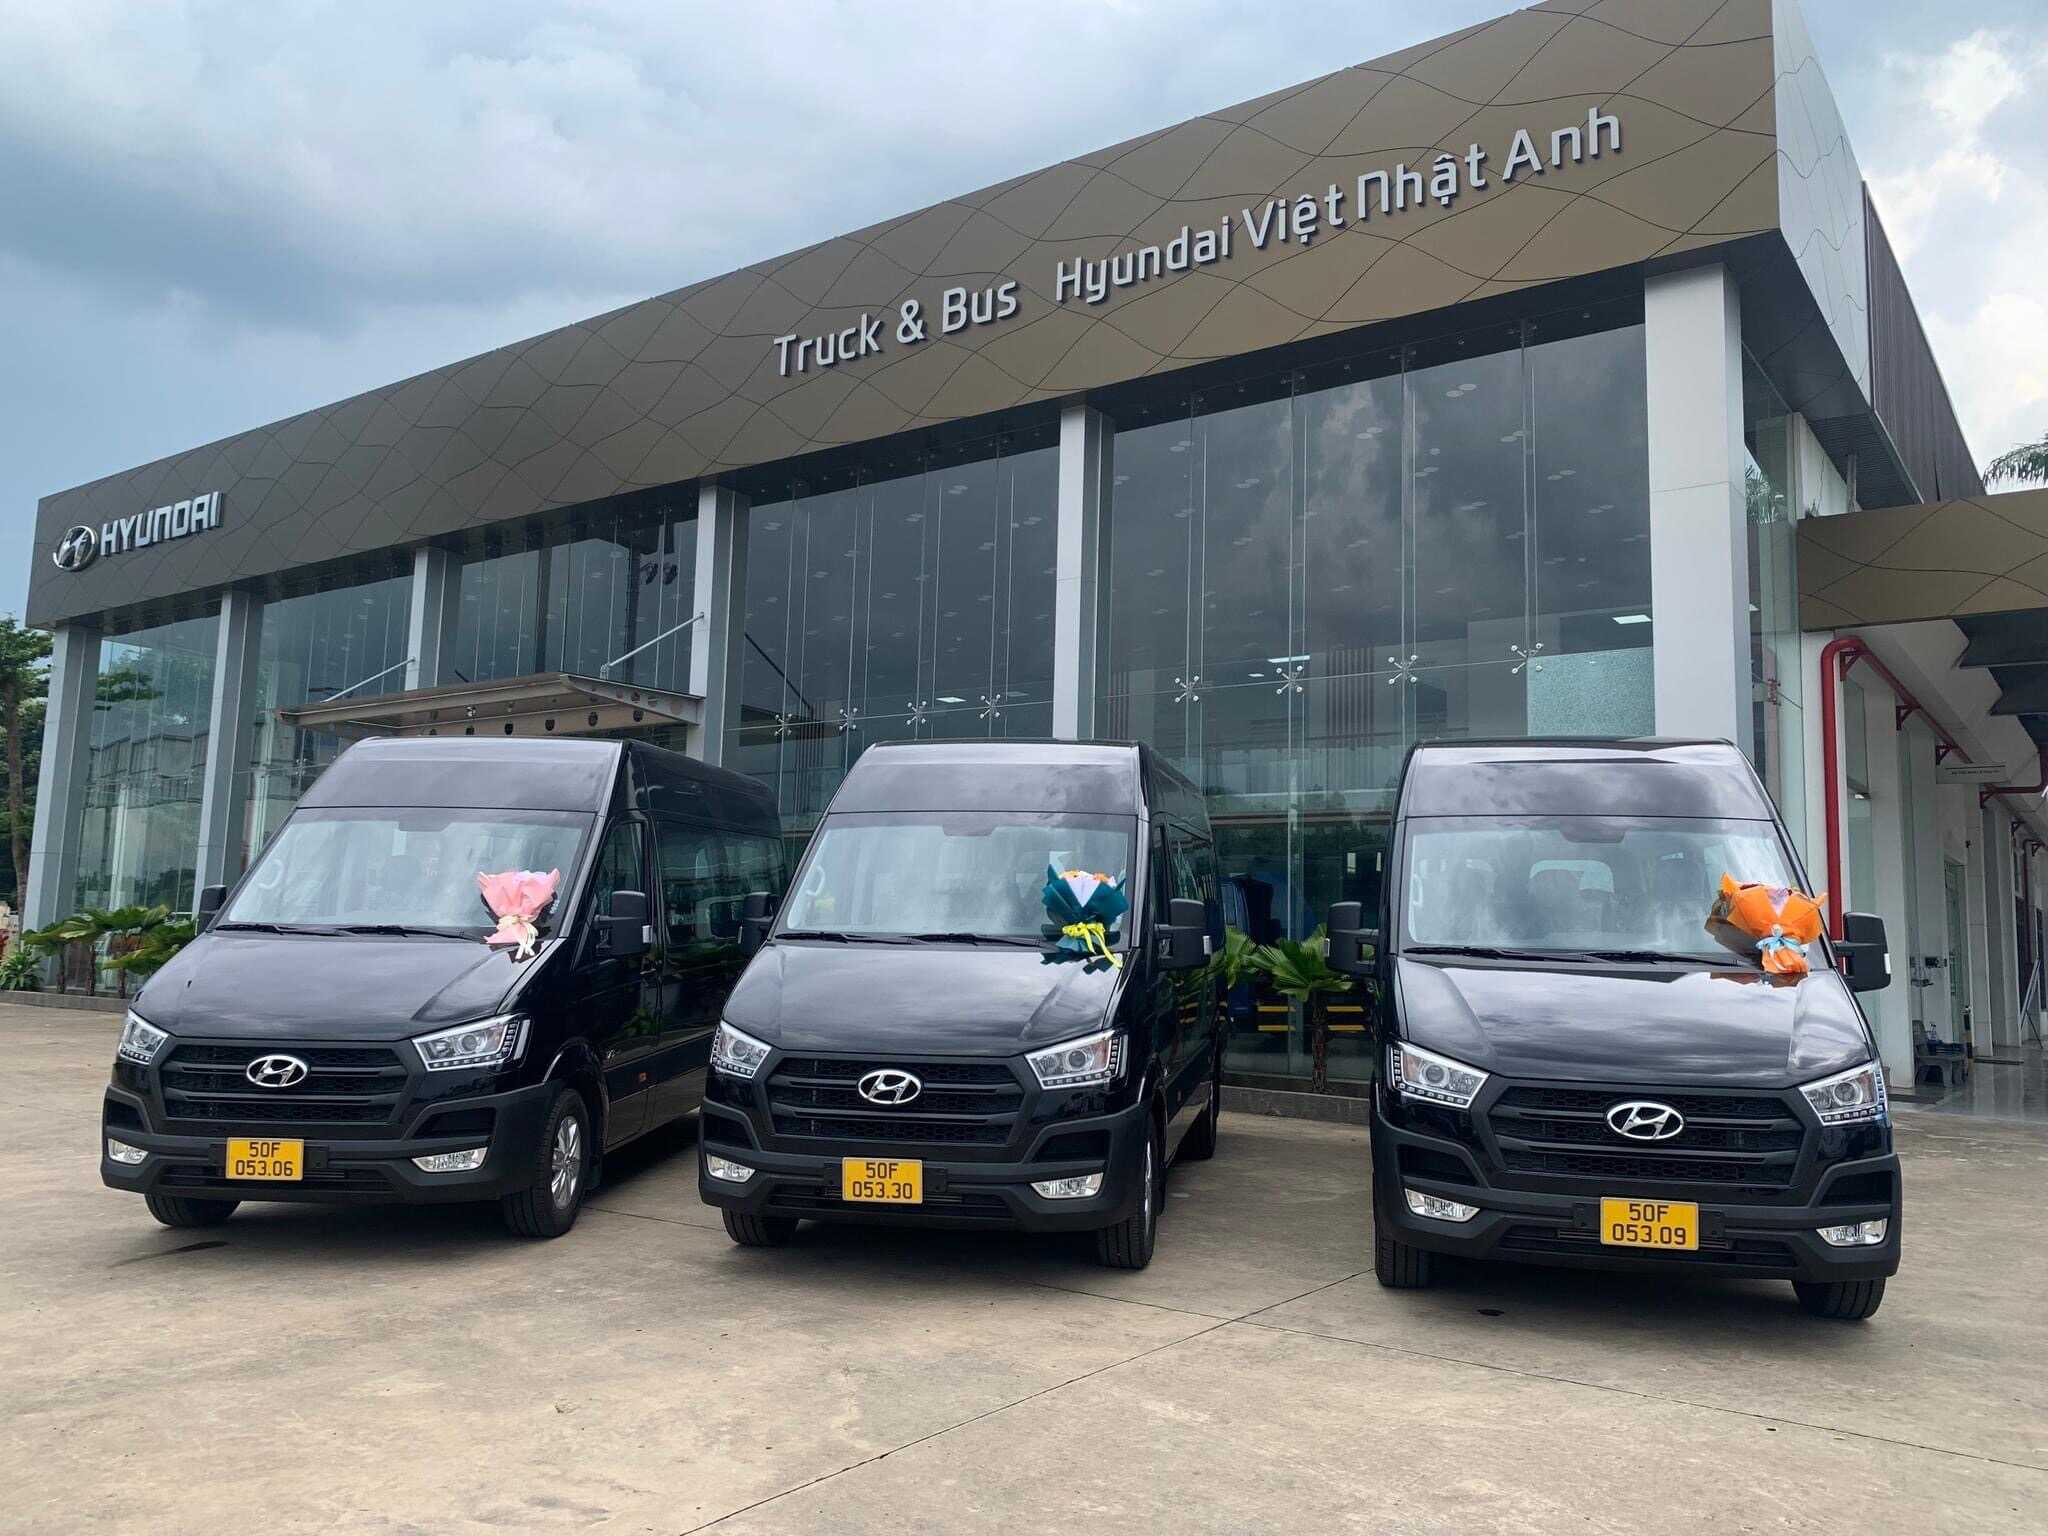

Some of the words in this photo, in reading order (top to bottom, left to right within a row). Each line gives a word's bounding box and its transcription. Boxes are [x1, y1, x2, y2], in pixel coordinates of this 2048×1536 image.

[773, 313, 882, 376] Truck
[896, 299, 926, 344] &
[942, 281, 1018, 333] Bus
[1056, 215, 1231, 304] Hyundai
[1242, 184, 1344, 248] Việt
[1358, 143, 1487, 220] Nhật
[1502, 107, 1621, 182] Anh
[100, 491, 221, 557] HYUNDAI
[249, 1142, 281, 1158] 50F
[235, 1160, 293, 1177] 053.06
[866, 1162, 899, 1179] 50F
[852, 1181, 913, 1199] 053.30
[1629, 1203, 1669, 1223] 50F
[1612, 1223, 1687, 1246] 053.09
